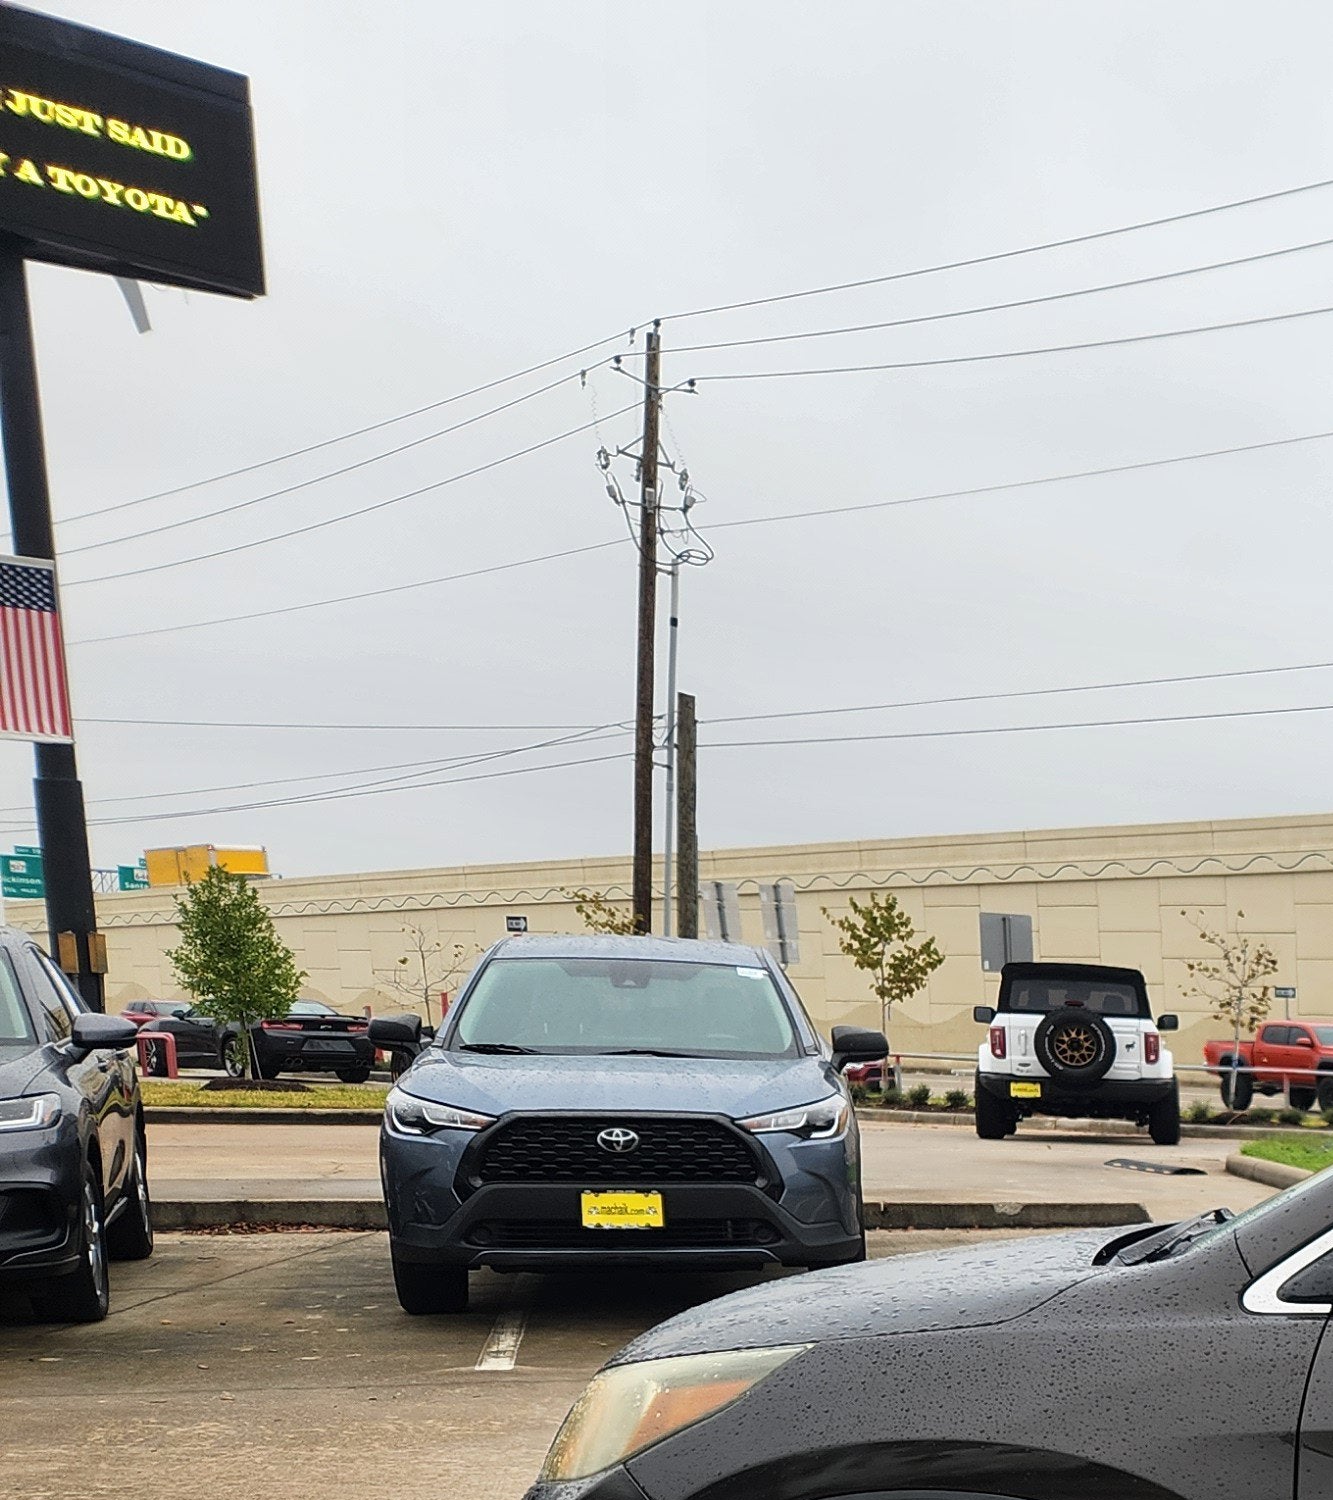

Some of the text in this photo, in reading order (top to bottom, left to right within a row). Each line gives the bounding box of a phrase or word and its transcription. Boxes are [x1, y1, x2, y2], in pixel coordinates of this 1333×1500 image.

[5, 88, 103, 137] JUST
[106, 117, 194, 162] SAID
[13, 158, 45, 188] A
